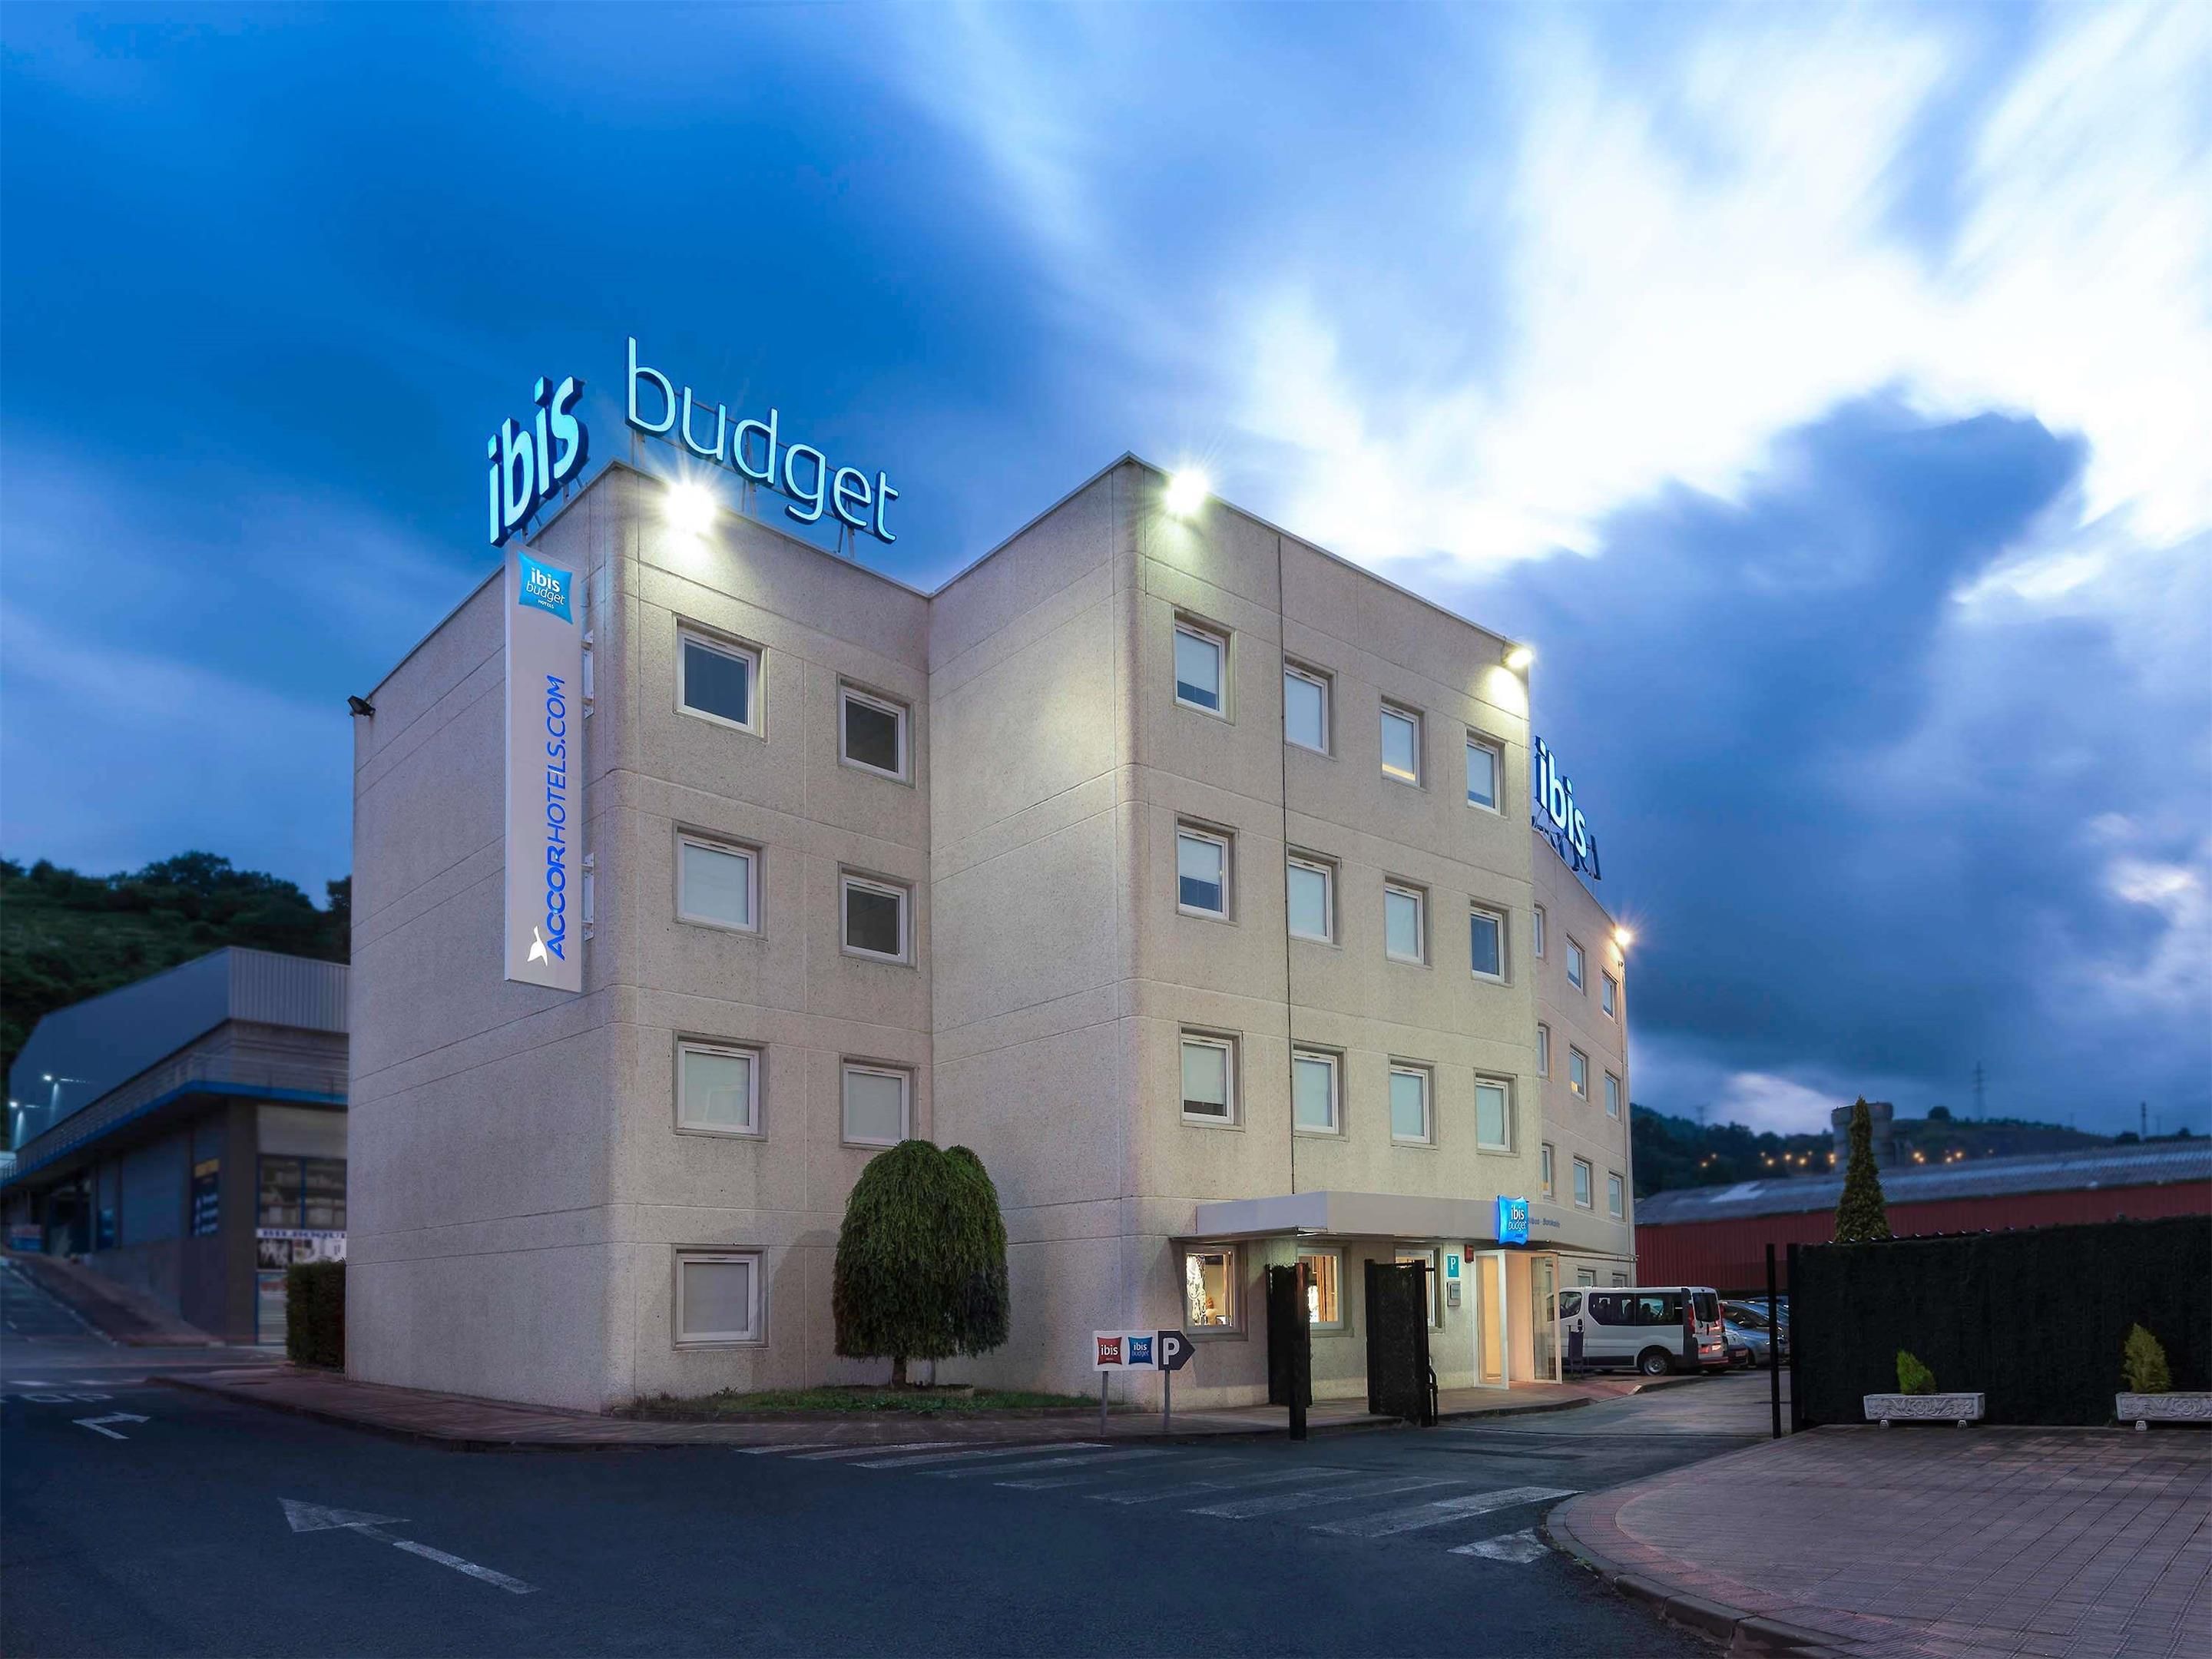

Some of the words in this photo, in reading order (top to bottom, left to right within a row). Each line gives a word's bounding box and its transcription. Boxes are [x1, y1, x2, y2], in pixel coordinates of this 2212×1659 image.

[625, 336, 899, 544] budget
[487, 376, 587, 547] ibis
[525, 580, 566, 605] budget
[531, 567, 561, 593] ibis
[1536, 735, 1588, 859] ibis
[546, 674, 566, 962] ACCORHOTELS.COM
[1511, 1204, 1525, 1220] ibis
[1508, 1220, 1527, 1232] budget
[1101, 1344, 1119, 1356] ibis
[1133, 1341, 1147, 1351] ibis
[1163, 1337, 1181, 1365] P
